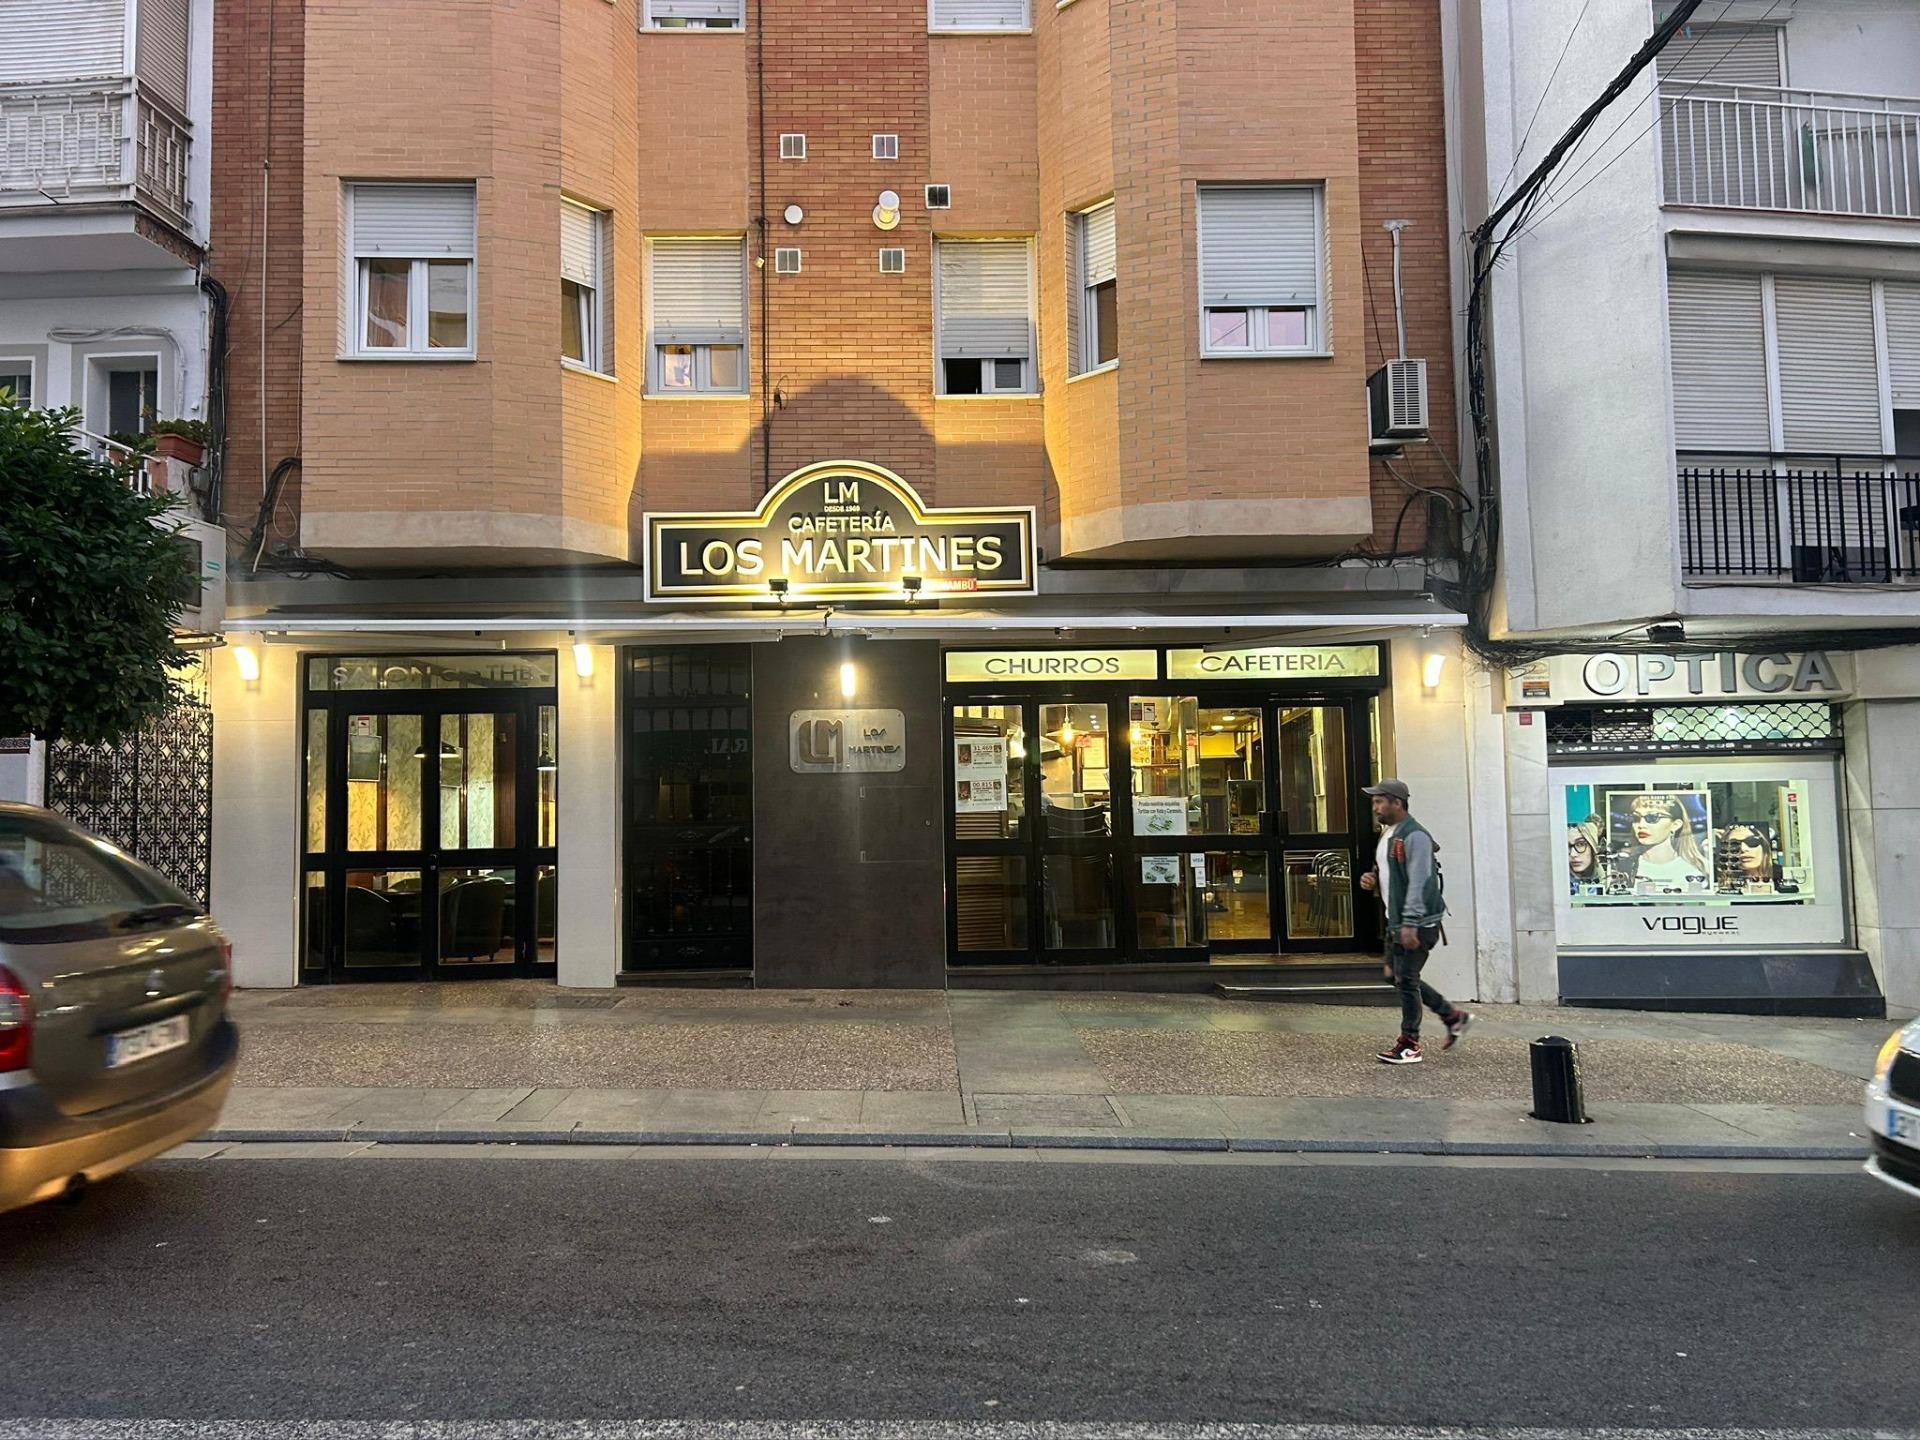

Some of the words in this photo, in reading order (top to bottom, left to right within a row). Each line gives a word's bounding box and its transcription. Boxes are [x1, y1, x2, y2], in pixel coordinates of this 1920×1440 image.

[824, 481, 859, 504] LM
[788, 510, 896, 533] CAFETERÍA
[680, 540, 765, 575] LOS
[780, 536, 1004, 574] MARTINES
[984, 656, 1121, 675] CHURROS
[1200, 653, 1346, 673] CAFETERIA
[848, 744, 901, 754] MARTINES
